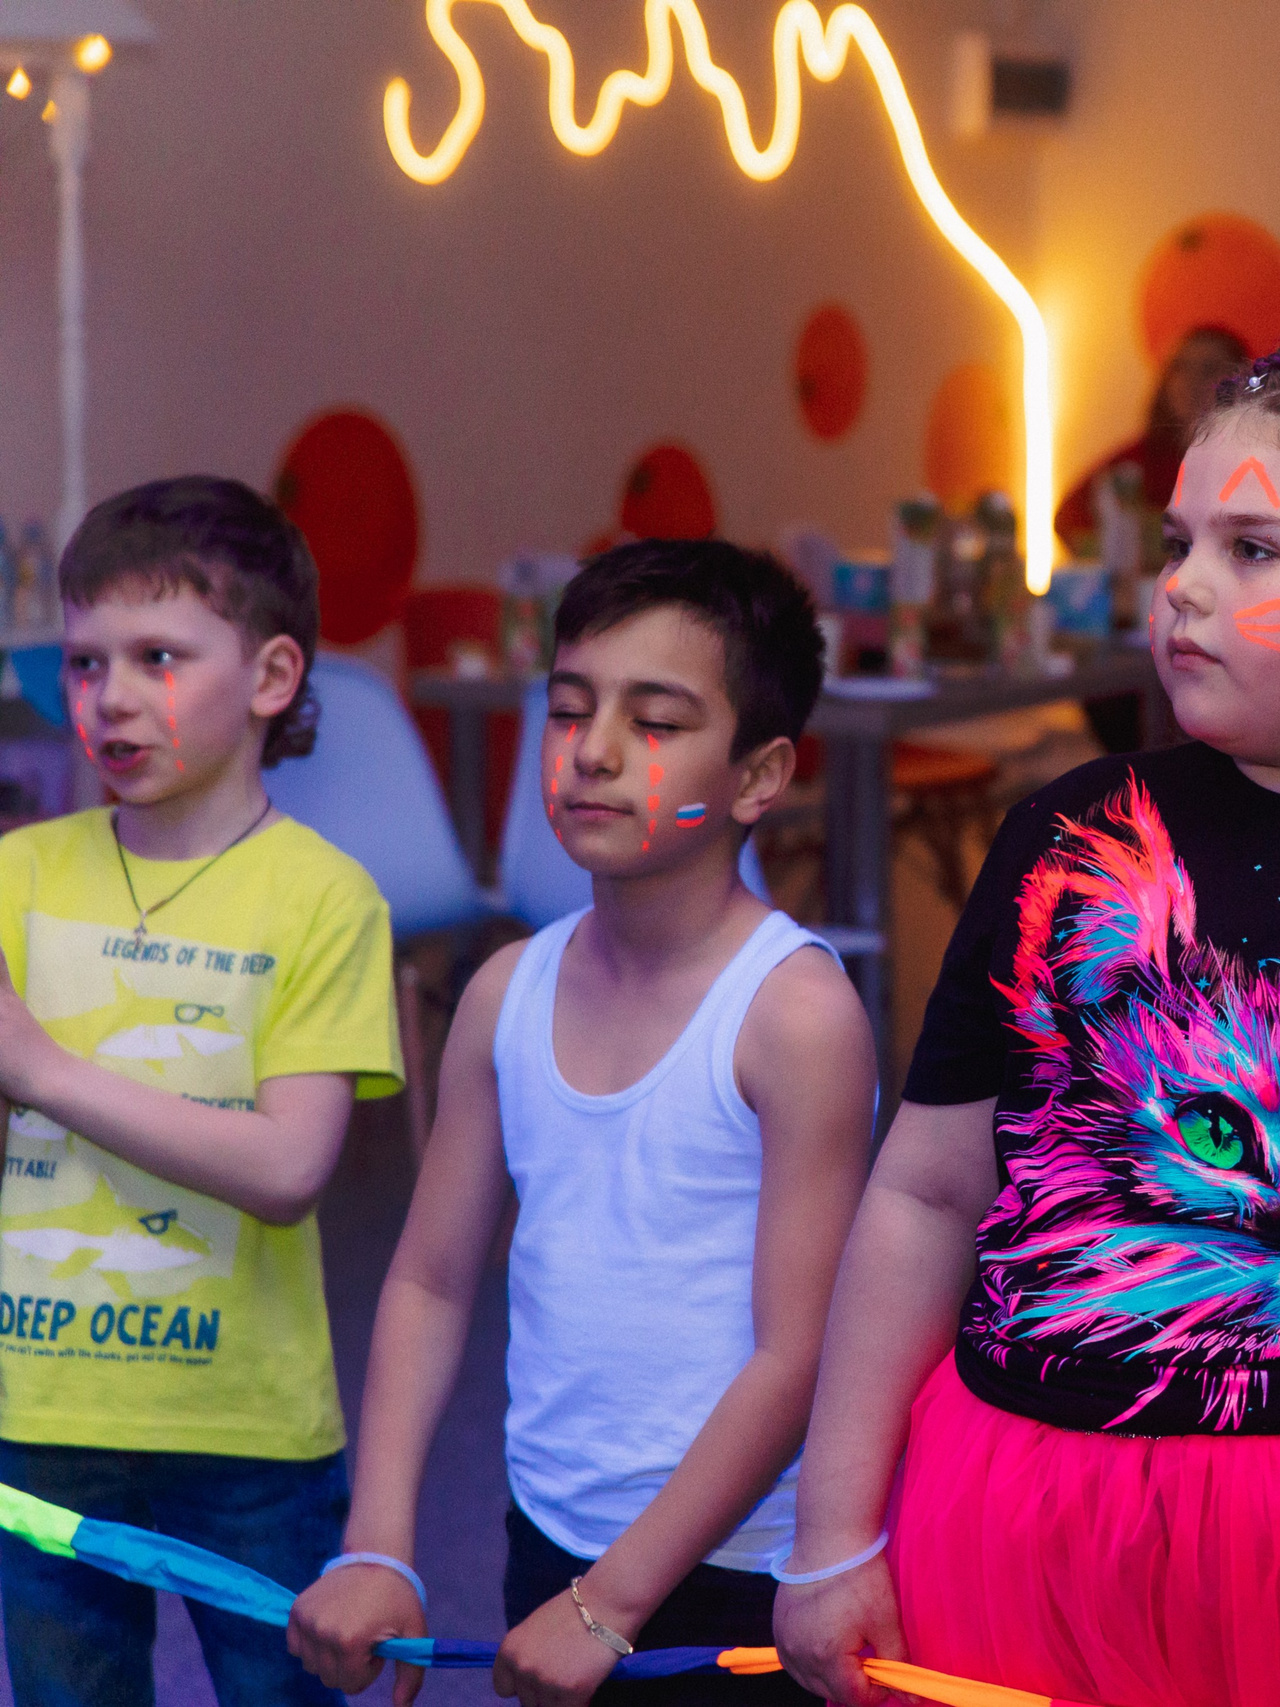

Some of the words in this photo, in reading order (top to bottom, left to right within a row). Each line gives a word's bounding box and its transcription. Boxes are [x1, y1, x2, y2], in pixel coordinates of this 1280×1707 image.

[101, 936, 171, 964] LEGENDS
[175, 945, 198, 966] OF
[205, 950, 236, 973] THE
[240, 952, 276, 975] DEEP
[6, 1155, 58, 1179] TTABLE
[0, 1291, 76, 1341] DEEP
[90, 1302, 220, 1351] OCEAN
